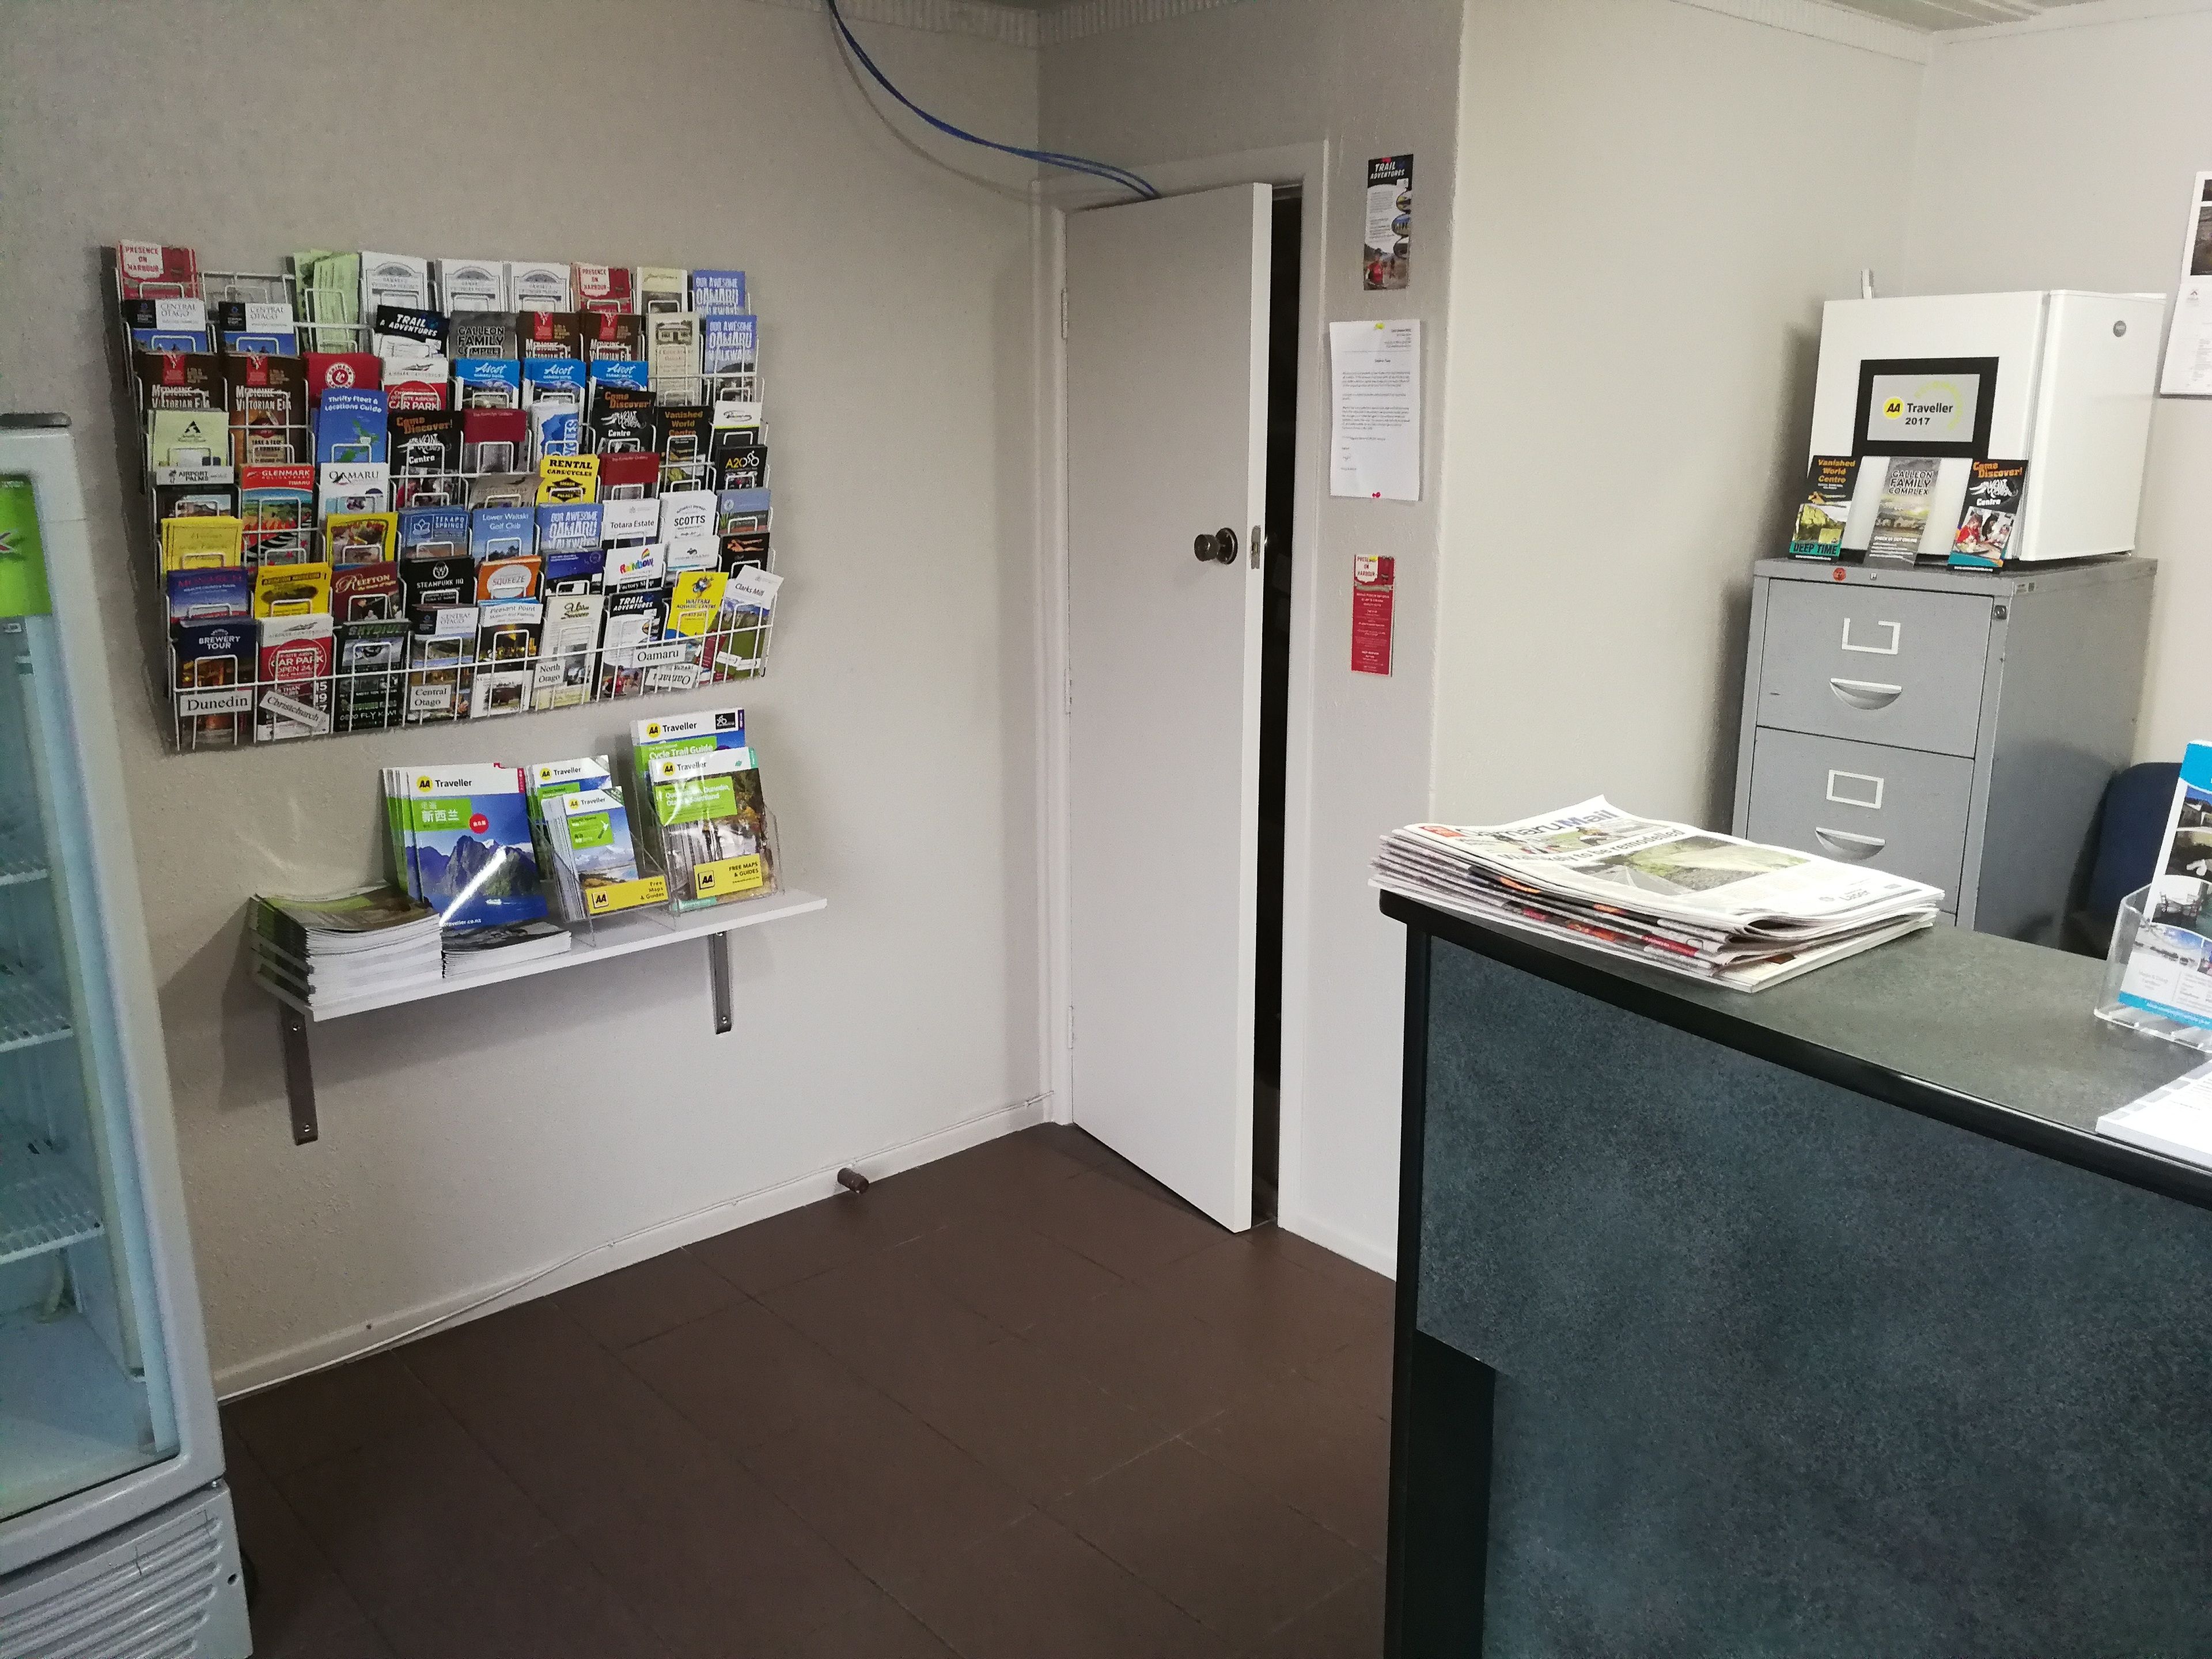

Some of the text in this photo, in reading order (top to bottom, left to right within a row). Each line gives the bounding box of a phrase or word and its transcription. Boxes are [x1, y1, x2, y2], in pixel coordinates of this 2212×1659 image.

[1375, 161, 1395, 172] TRAIL
[696, 289, 738, 305] OAMARU
[397, 314, 427, 328] TRAIL
[389, 319, 438, 337] ADVENTURES
[458, 326, 505, 335] GALLEON
[458, 335, 505, 346] FAMILY
[709, 332, 752, 349] OAMARU
[605, 392, 629, 400] Come
[1887, 403, 1953, 413] AA Traveller
[664, 411, 703, 419] Vanished
[396, 416, 425, 426] Come
[1905, 417, 1930, 425] 2017
[549, 460, 593, 469] RENTAL
[1818, 459, 1856, 467] Vanished
[1972, 461, 1998, 471] Come
[1822, 467, 1846, 475] World
[1891, 469, 1934, 479] GALLEON
[1978, 467, 2023, 478] Discover!
[1818, 475, 1846, 483] Centre
[1890, 478, 1931, 488] FAMILY
[1888, 487, 1930, 496] COMPLEX
[1976, 498, 2001, 506] Centre
[482, 513, 505, 521] Lower
[565, 511, 598, 521] AWESOME
[674, 515, 706, 527] SCOTTS
[489, 521, 521, 530] Golf Club
[634, 519, 654, 527] Estate
[550, 521, 597, 538] OAMARU
[1793, 543, 1838, 555] DEEP TIME
[492, 576, 525, 586] SQUEEZE
[735, 582, 752, 593] Clarks
[619, 596, 643, 605] TRAIL
[199, 635, 241, 645] BREWERY
[637, 649, 679, 662] Oamaru
[539, 663, 560, 673] North
[539, 674, 560, 683] Otago
[415, 688, 447, 696] Central
[187, 696, 248, 711] Dunedin
[267, 696, 319, 722] Christchurch
[648, 722, 697, 734] AA Traveller
[649, 744, 713, 760] Cycle Trail Guide
[554, 767, 582, 776] Traveller
[677, 762, 707, 771] Traveller
[419, 779, 472, 788] AA Traveller
[581, 797, 606, 806] Traveller
[743, 861, 758, 869] MAPS
[739, 868, 759, 877] GUIDES
[702, 873, 713, 885] AA
[596, 893, 607, 903] AA
